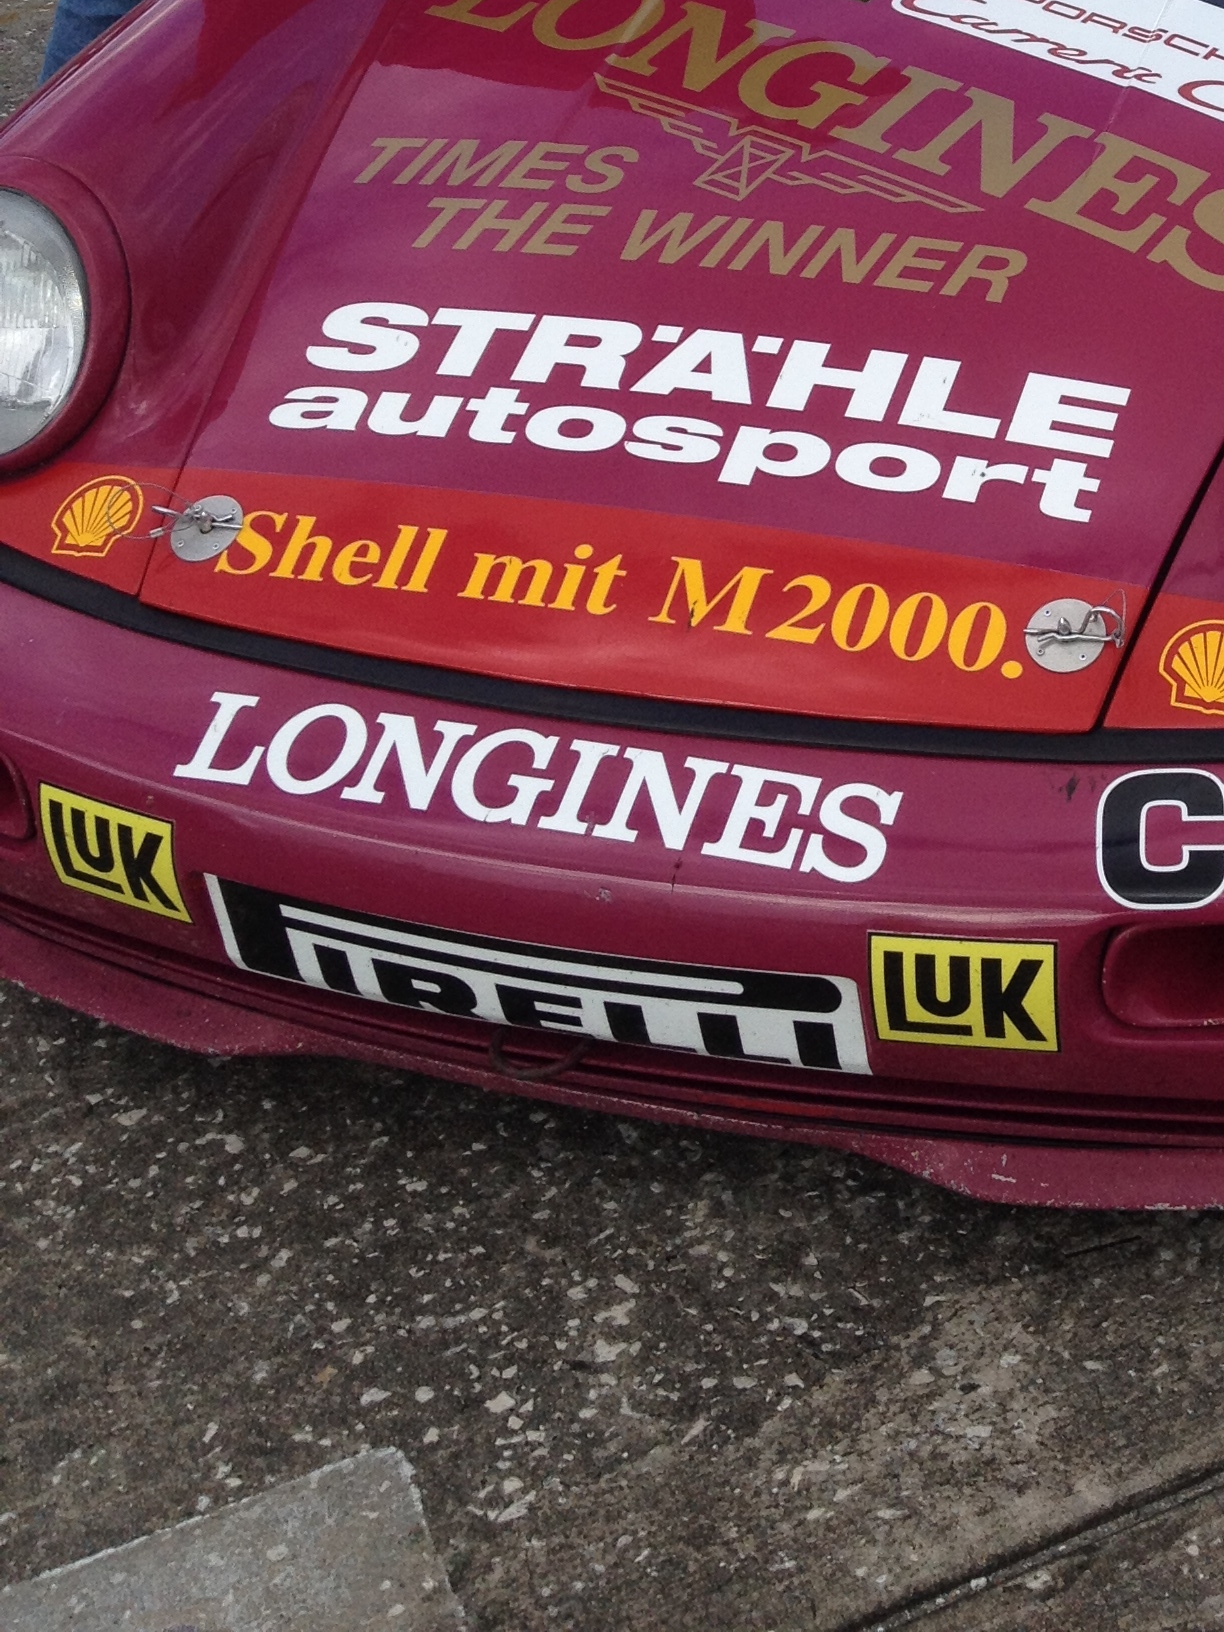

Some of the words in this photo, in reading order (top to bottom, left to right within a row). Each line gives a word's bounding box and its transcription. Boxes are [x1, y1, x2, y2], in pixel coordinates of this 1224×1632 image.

[352, 136, 641, 195] TIMES
[411, 196, 614, 256] THE
[619, 209, 1029, 302] WINNER
[304, 301, 1131, 458] STRÄHLE
[269, 385, 1101, 523] autosport
[215, 509, 432, 593] Shell
[467, 541, 625, 617] mit
[175, 691, 903, 884] LONGINES
[207, 874, 845, 1073] PIRELLI
